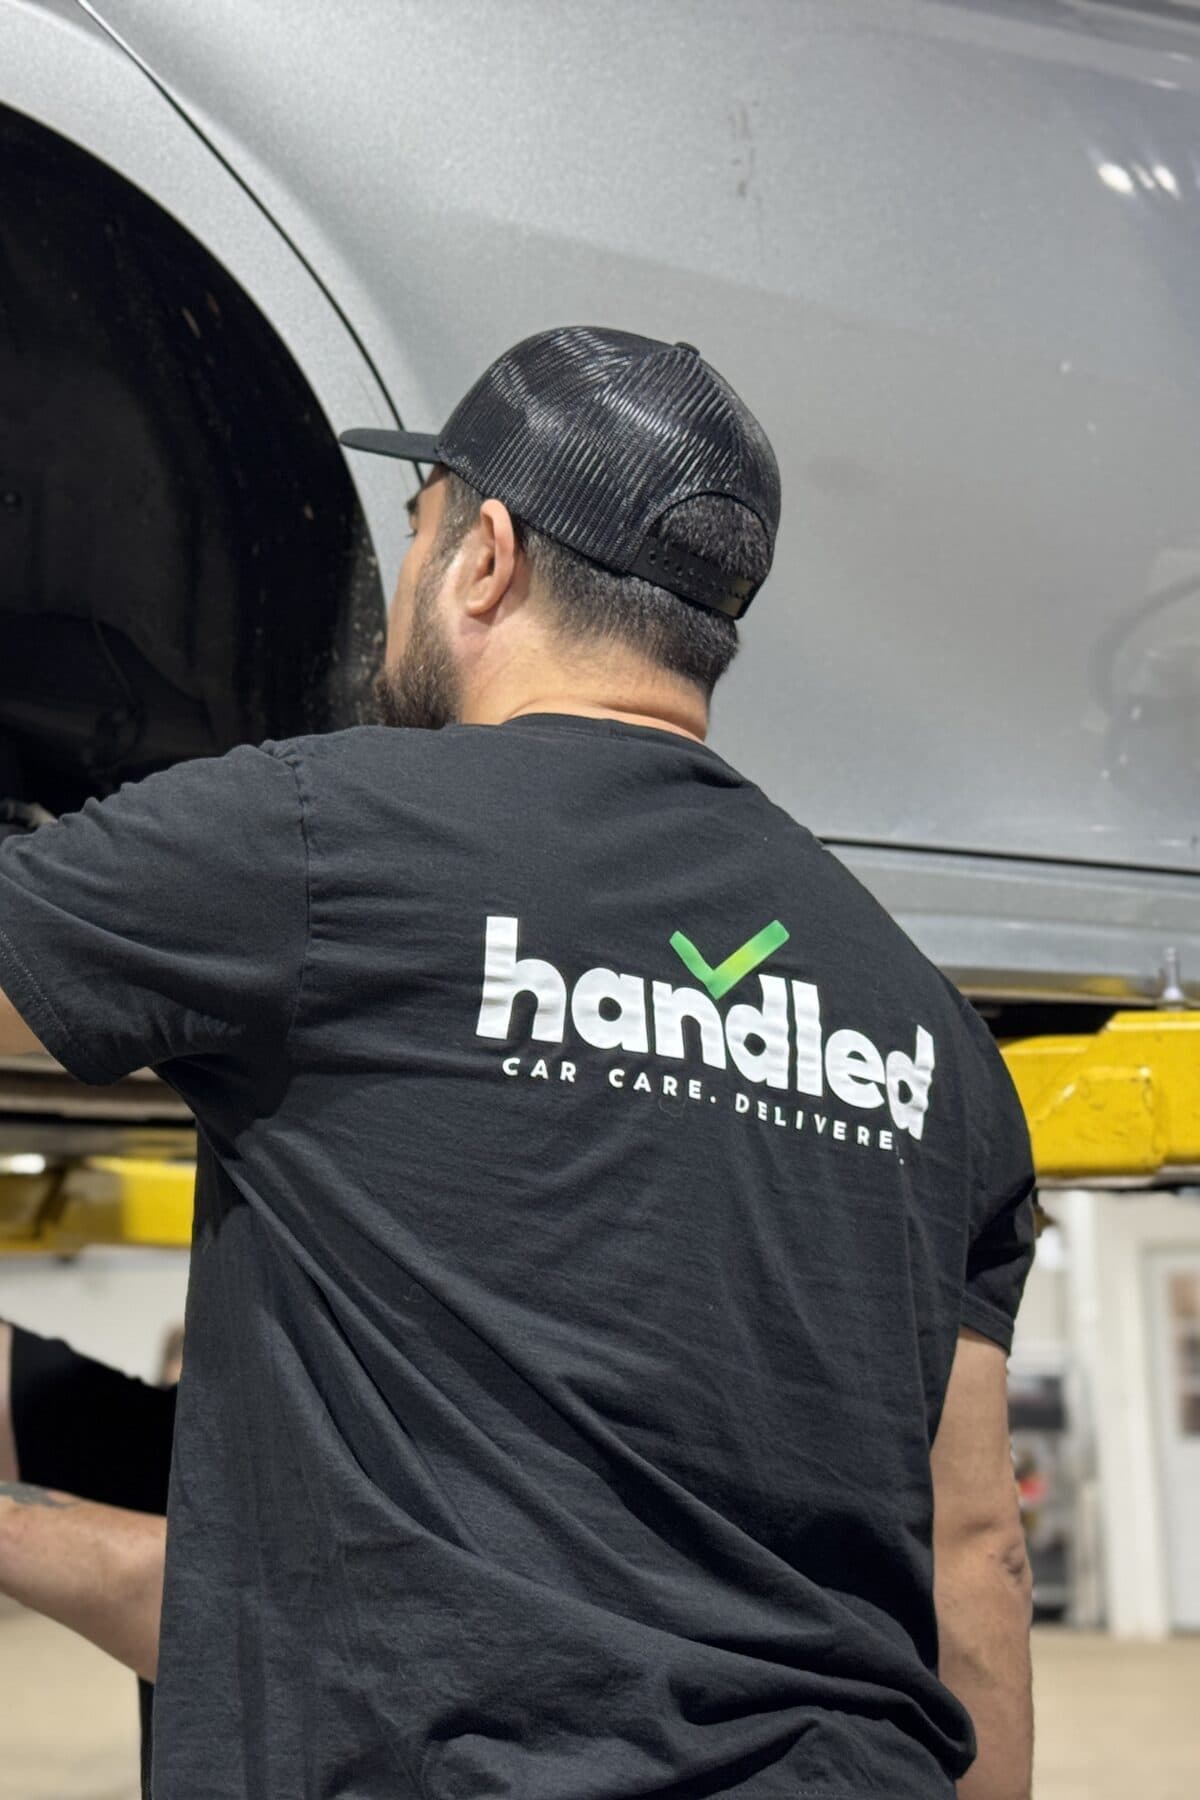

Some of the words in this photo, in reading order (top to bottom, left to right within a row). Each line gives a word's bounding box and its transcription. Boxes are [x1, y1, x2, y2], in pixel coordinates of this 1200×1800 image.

[475, 915, 935, 1140] handled
[502, 1056, 577, 1083] CAR
[608, 1068, 717, 1104] CARE.
